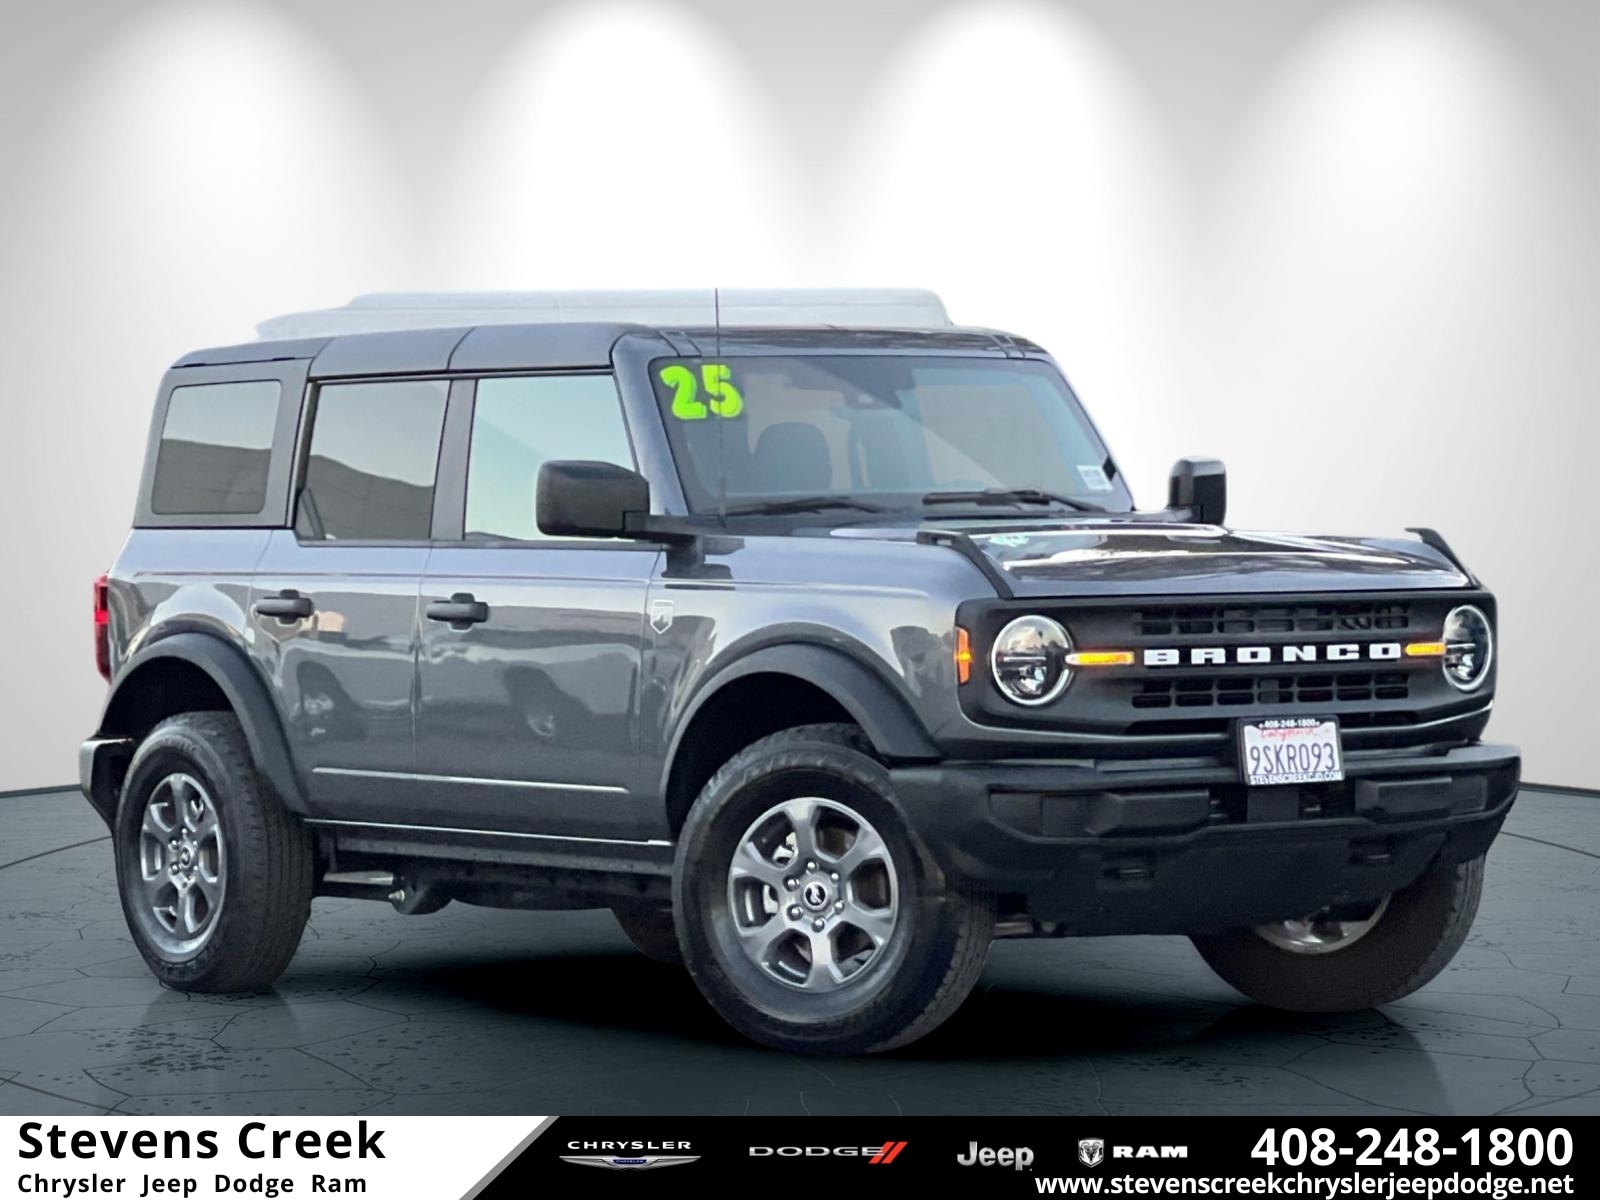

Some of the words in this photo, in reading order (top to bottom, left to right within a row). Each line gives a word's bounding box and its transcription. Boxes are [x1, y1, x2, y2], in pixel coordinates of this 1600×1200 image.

[660, 364, 743, 420] 25
[1143, 643, 1402, 666] BRONCO
[1249, 742, 1336, 776] 9SKR093
